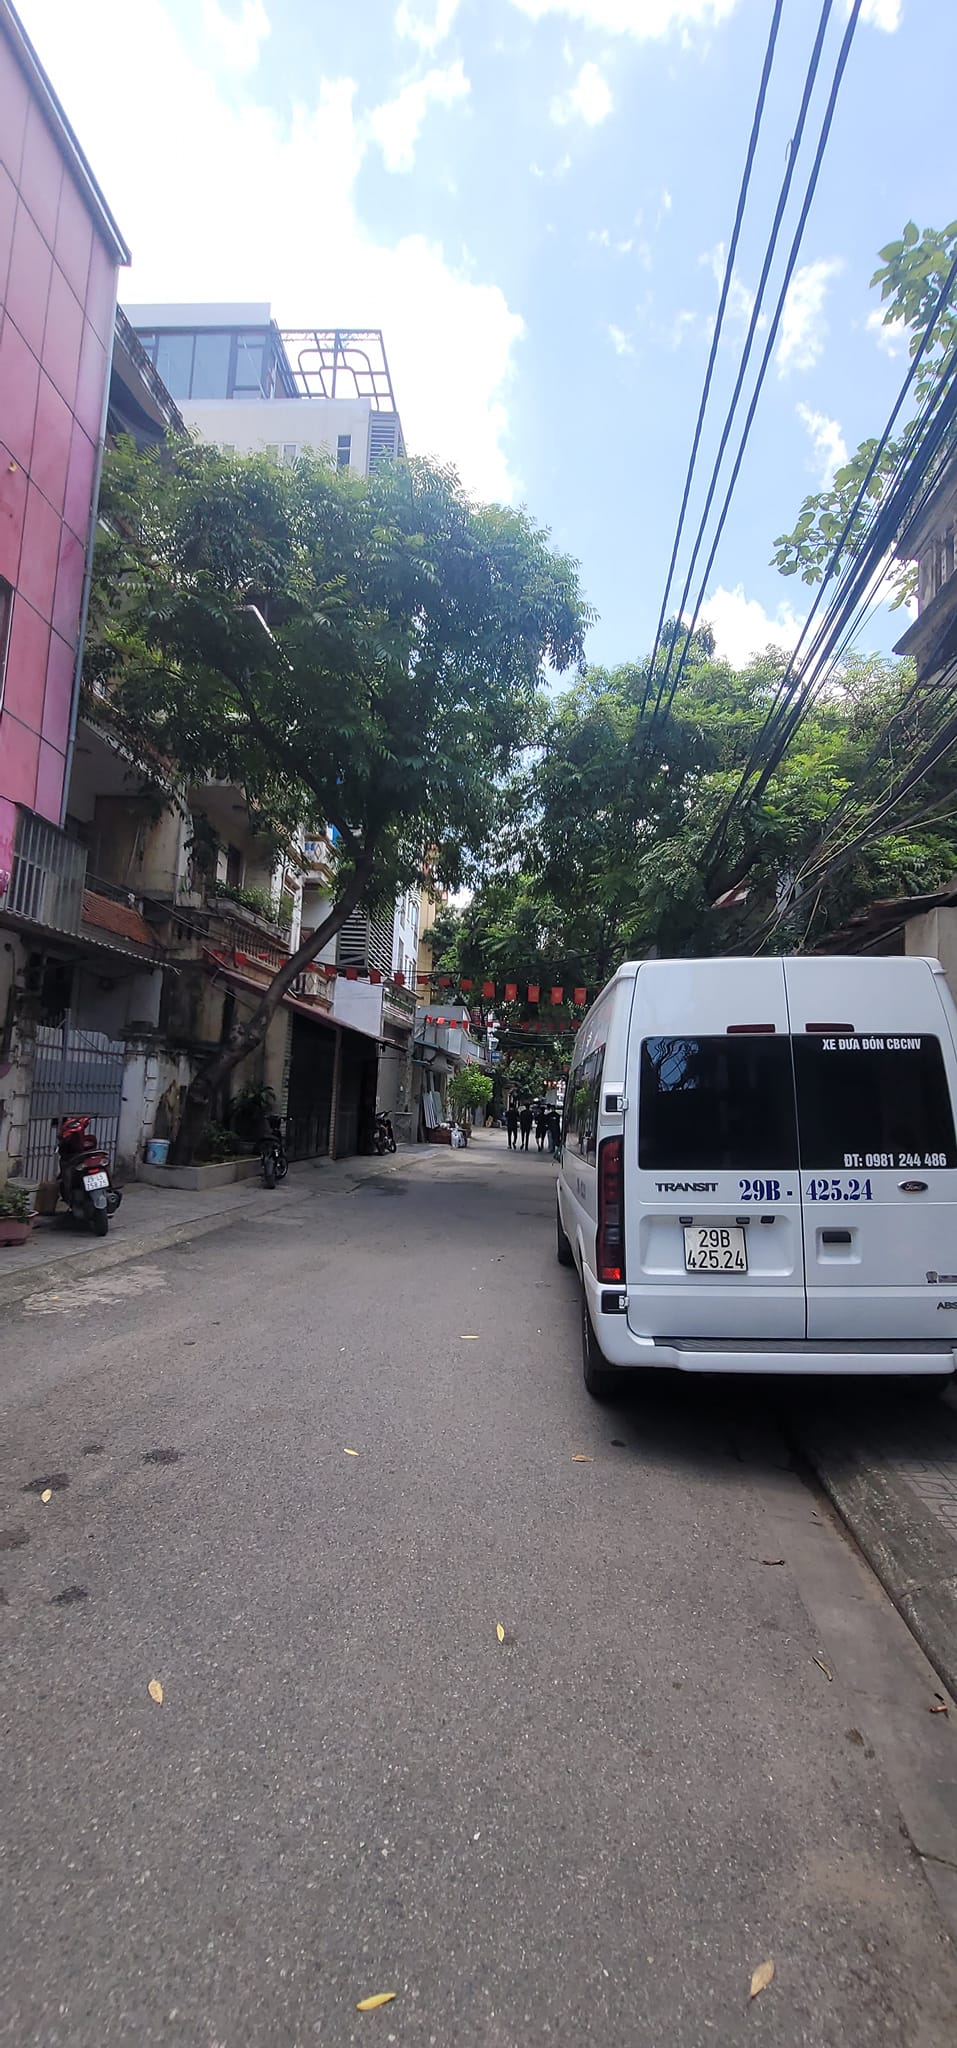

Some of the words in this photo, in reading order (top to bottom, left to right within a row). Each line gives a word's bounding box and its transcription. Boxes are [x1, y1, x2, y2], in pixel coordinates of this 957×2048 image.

[822, 1038, 836, 1050] XE
[838, 1038, 860, 1050] ĐƯA
[862, 1036, 884, 1050] ĐÓN
[886, 1038, 921, 1050] CBCNV
[843, 1153, 863, 1168] ĐT:
[865, 1153, 894, 1167] 0981
[898, 1153, 922, 1167] 244
[924, 1152, 947, 1167] 486
[655, 1182, 719, 1192] TRANSIT
[739, 1179, 781, 1201] 29B
[805, 1179, 873, 1201] 425.24
[698, 1229, 731, 1248] 29B
[687, 1250, 745, 1269] 425.24
